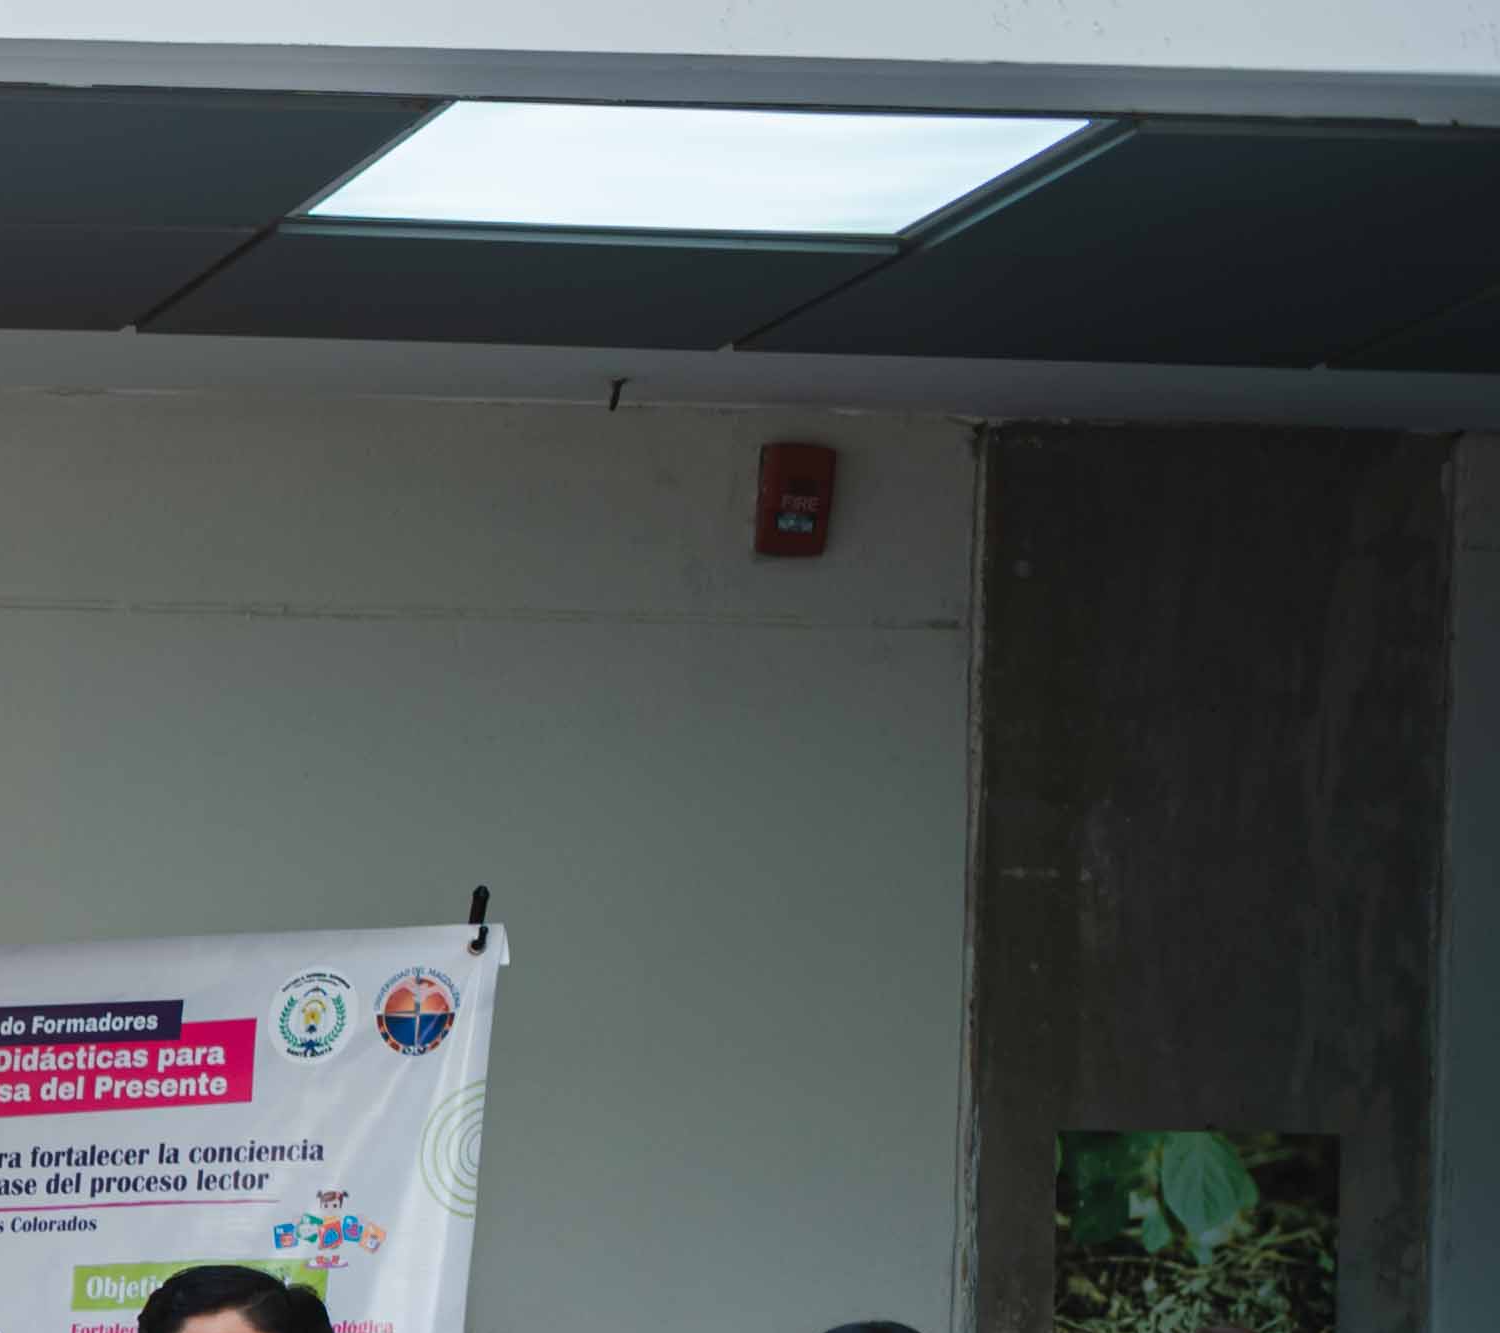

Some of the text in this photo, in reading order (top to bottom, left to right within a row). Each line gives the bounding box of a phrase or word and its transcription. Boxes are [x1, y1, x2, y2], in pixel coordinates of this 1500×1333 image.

[782, 495, 820, 511] FIRE
[31, 1011, 158, 1034] Formadores
[157, 1045, 225, 1070] para
[40, 1075, 85, 1101] del
[94, 1072, 227, 1099] Presente
[30, 1144, 150, 1168] fortalecer
[158, 1142, 179, 1164] la
[188, 1139, 323, 1164] conciencia
[45, 1171, 81, 1194] del
[90, 1175, 187, 1198] proceso
[196, 1169, 269, 1191] lector
[10, 1215, 97, 1232] Colorados
